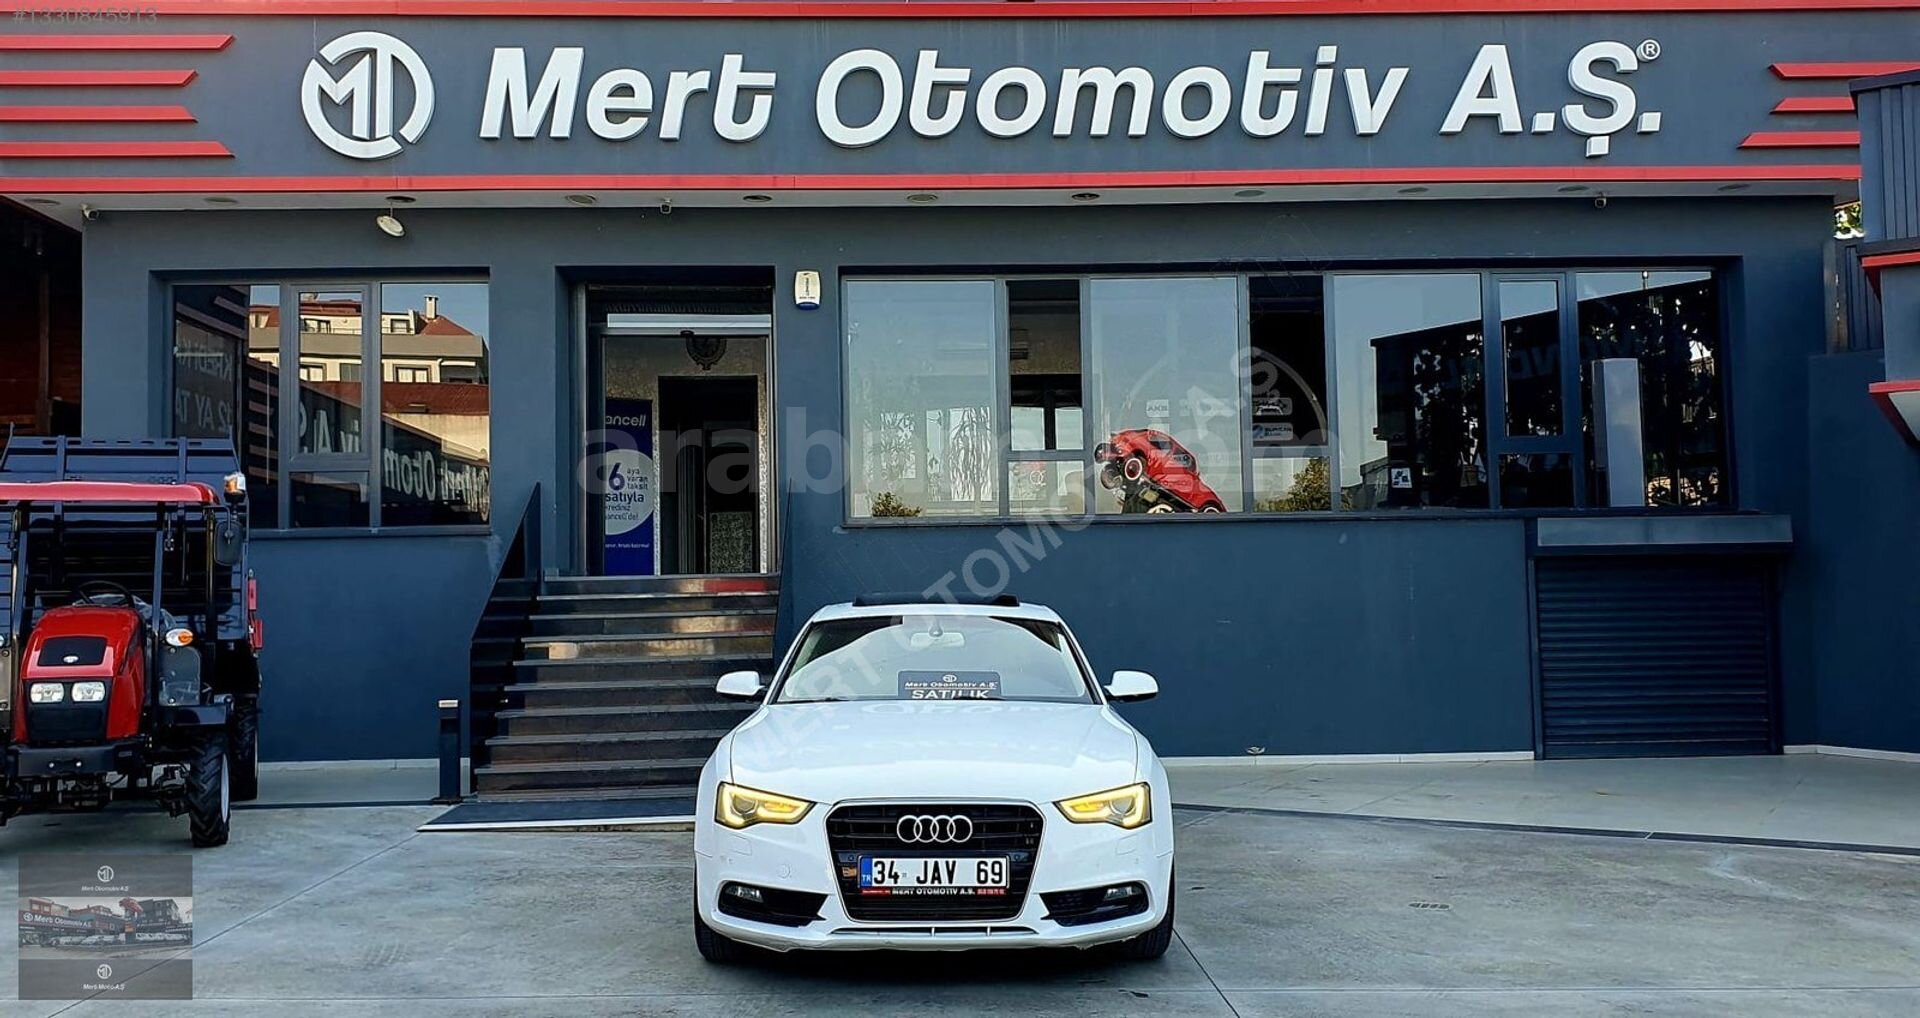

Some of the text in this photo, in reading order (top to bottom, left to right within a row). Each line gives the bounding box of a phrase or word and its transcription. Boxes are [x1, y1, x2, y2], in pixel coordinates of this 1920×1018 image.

[479, 47, 776, 142] Mert
[815, 45, 1409, 148] Otomotiv
[609, 463, 625, 491] 6
[874, 860, 900, 885] 34
[916, 860, 957, 885] JAV
[976, 860, 1003, 885] 69
